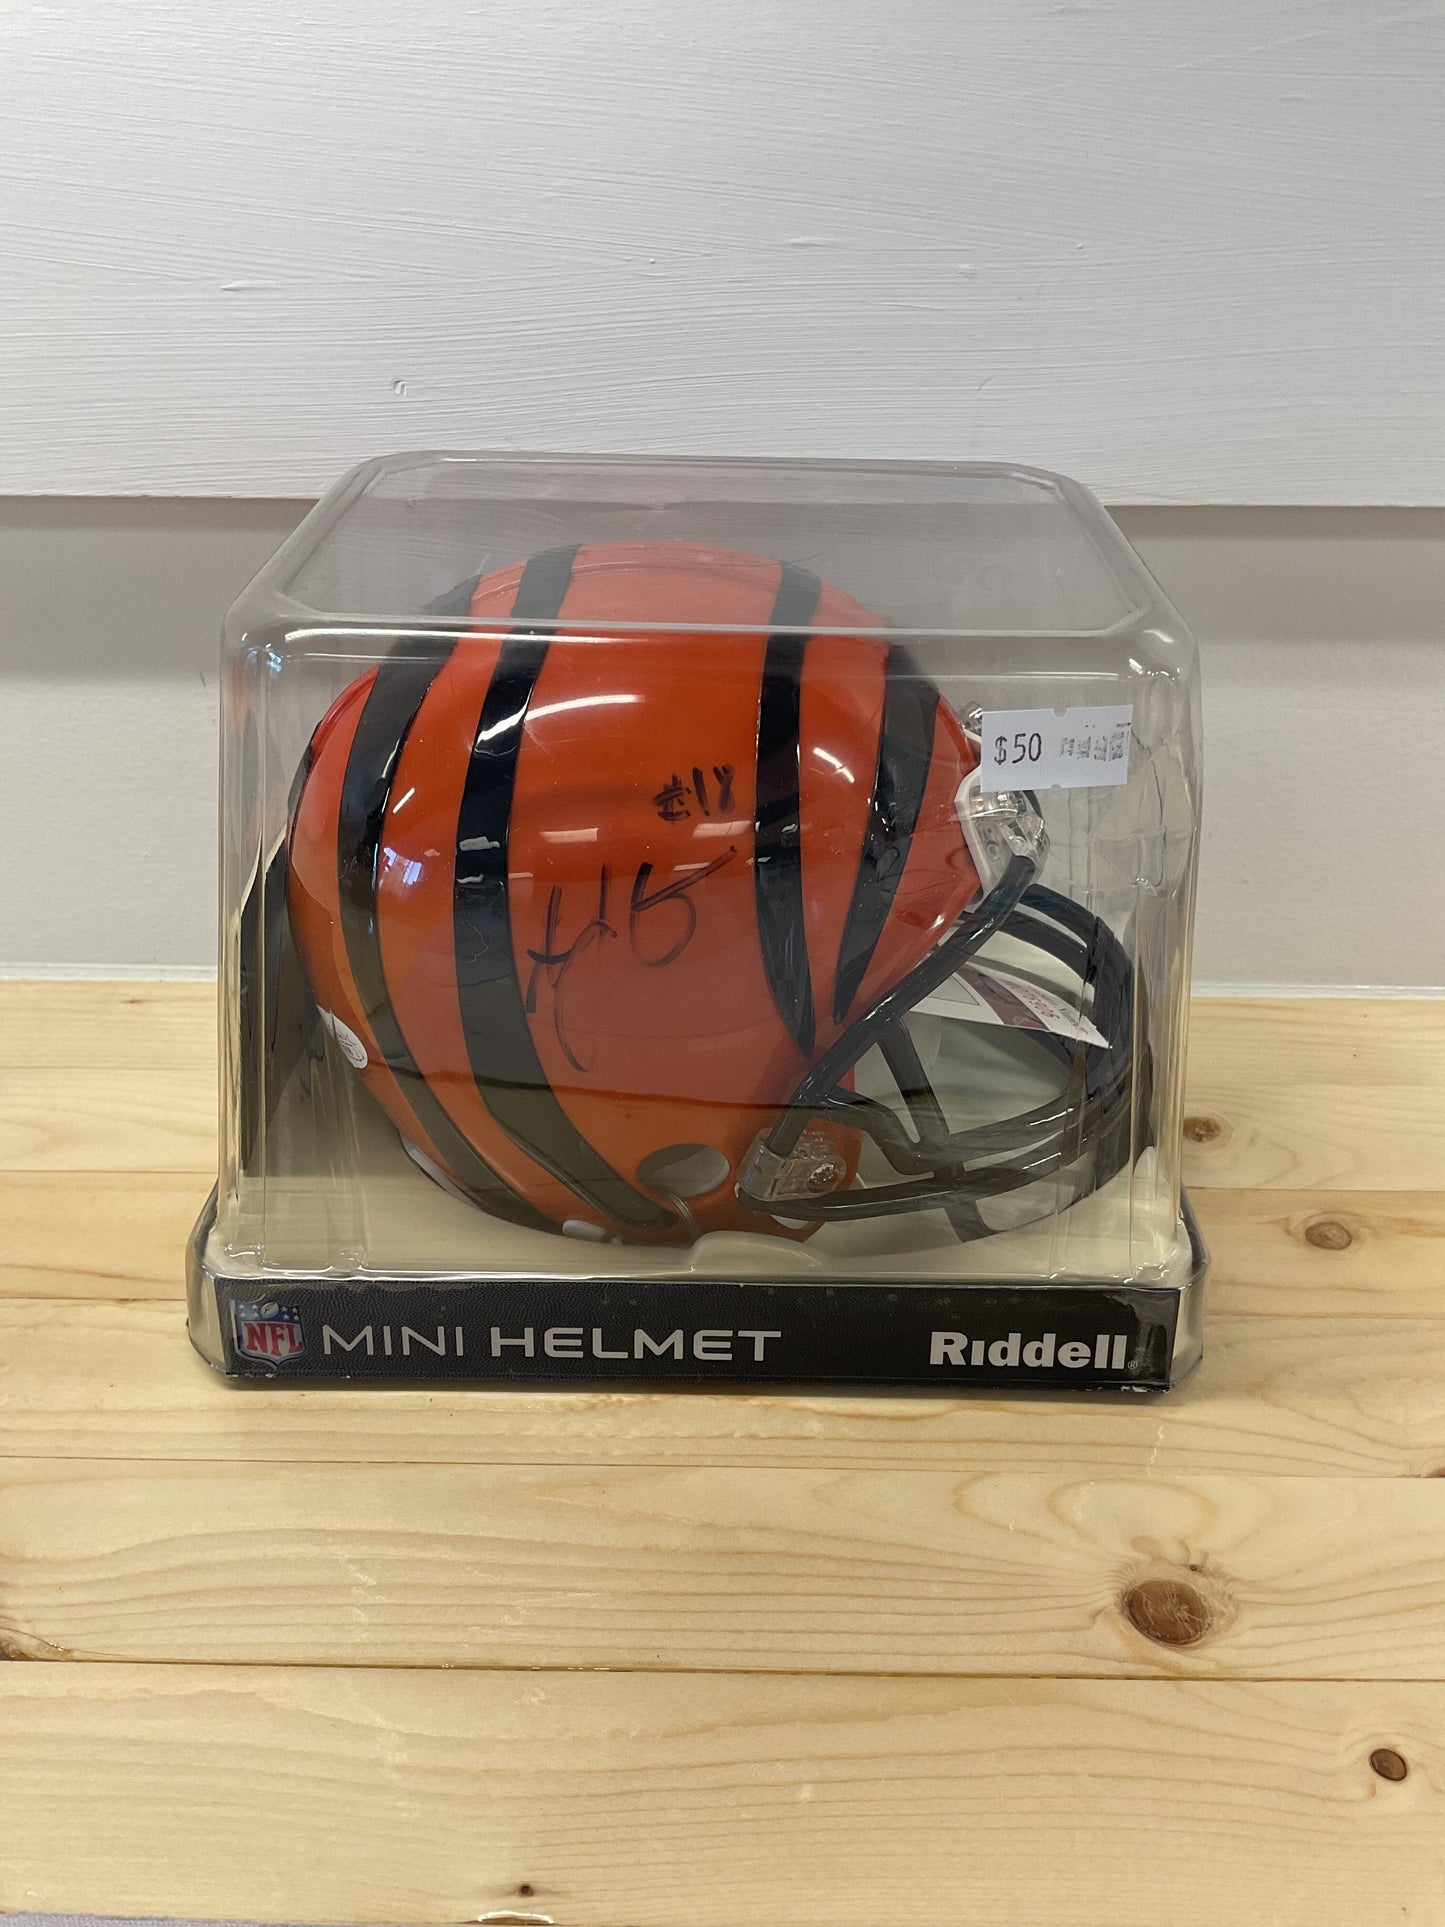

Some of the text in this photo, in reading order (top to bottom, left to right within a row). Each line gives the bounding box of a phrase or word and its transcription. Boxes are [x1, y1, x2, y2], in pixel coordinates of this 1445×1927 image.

[993, 732, 1042, 766] $50
[243, 1322, 303, 1357] NFL
[322, 1324, 782, 1362] MINI HELMET
